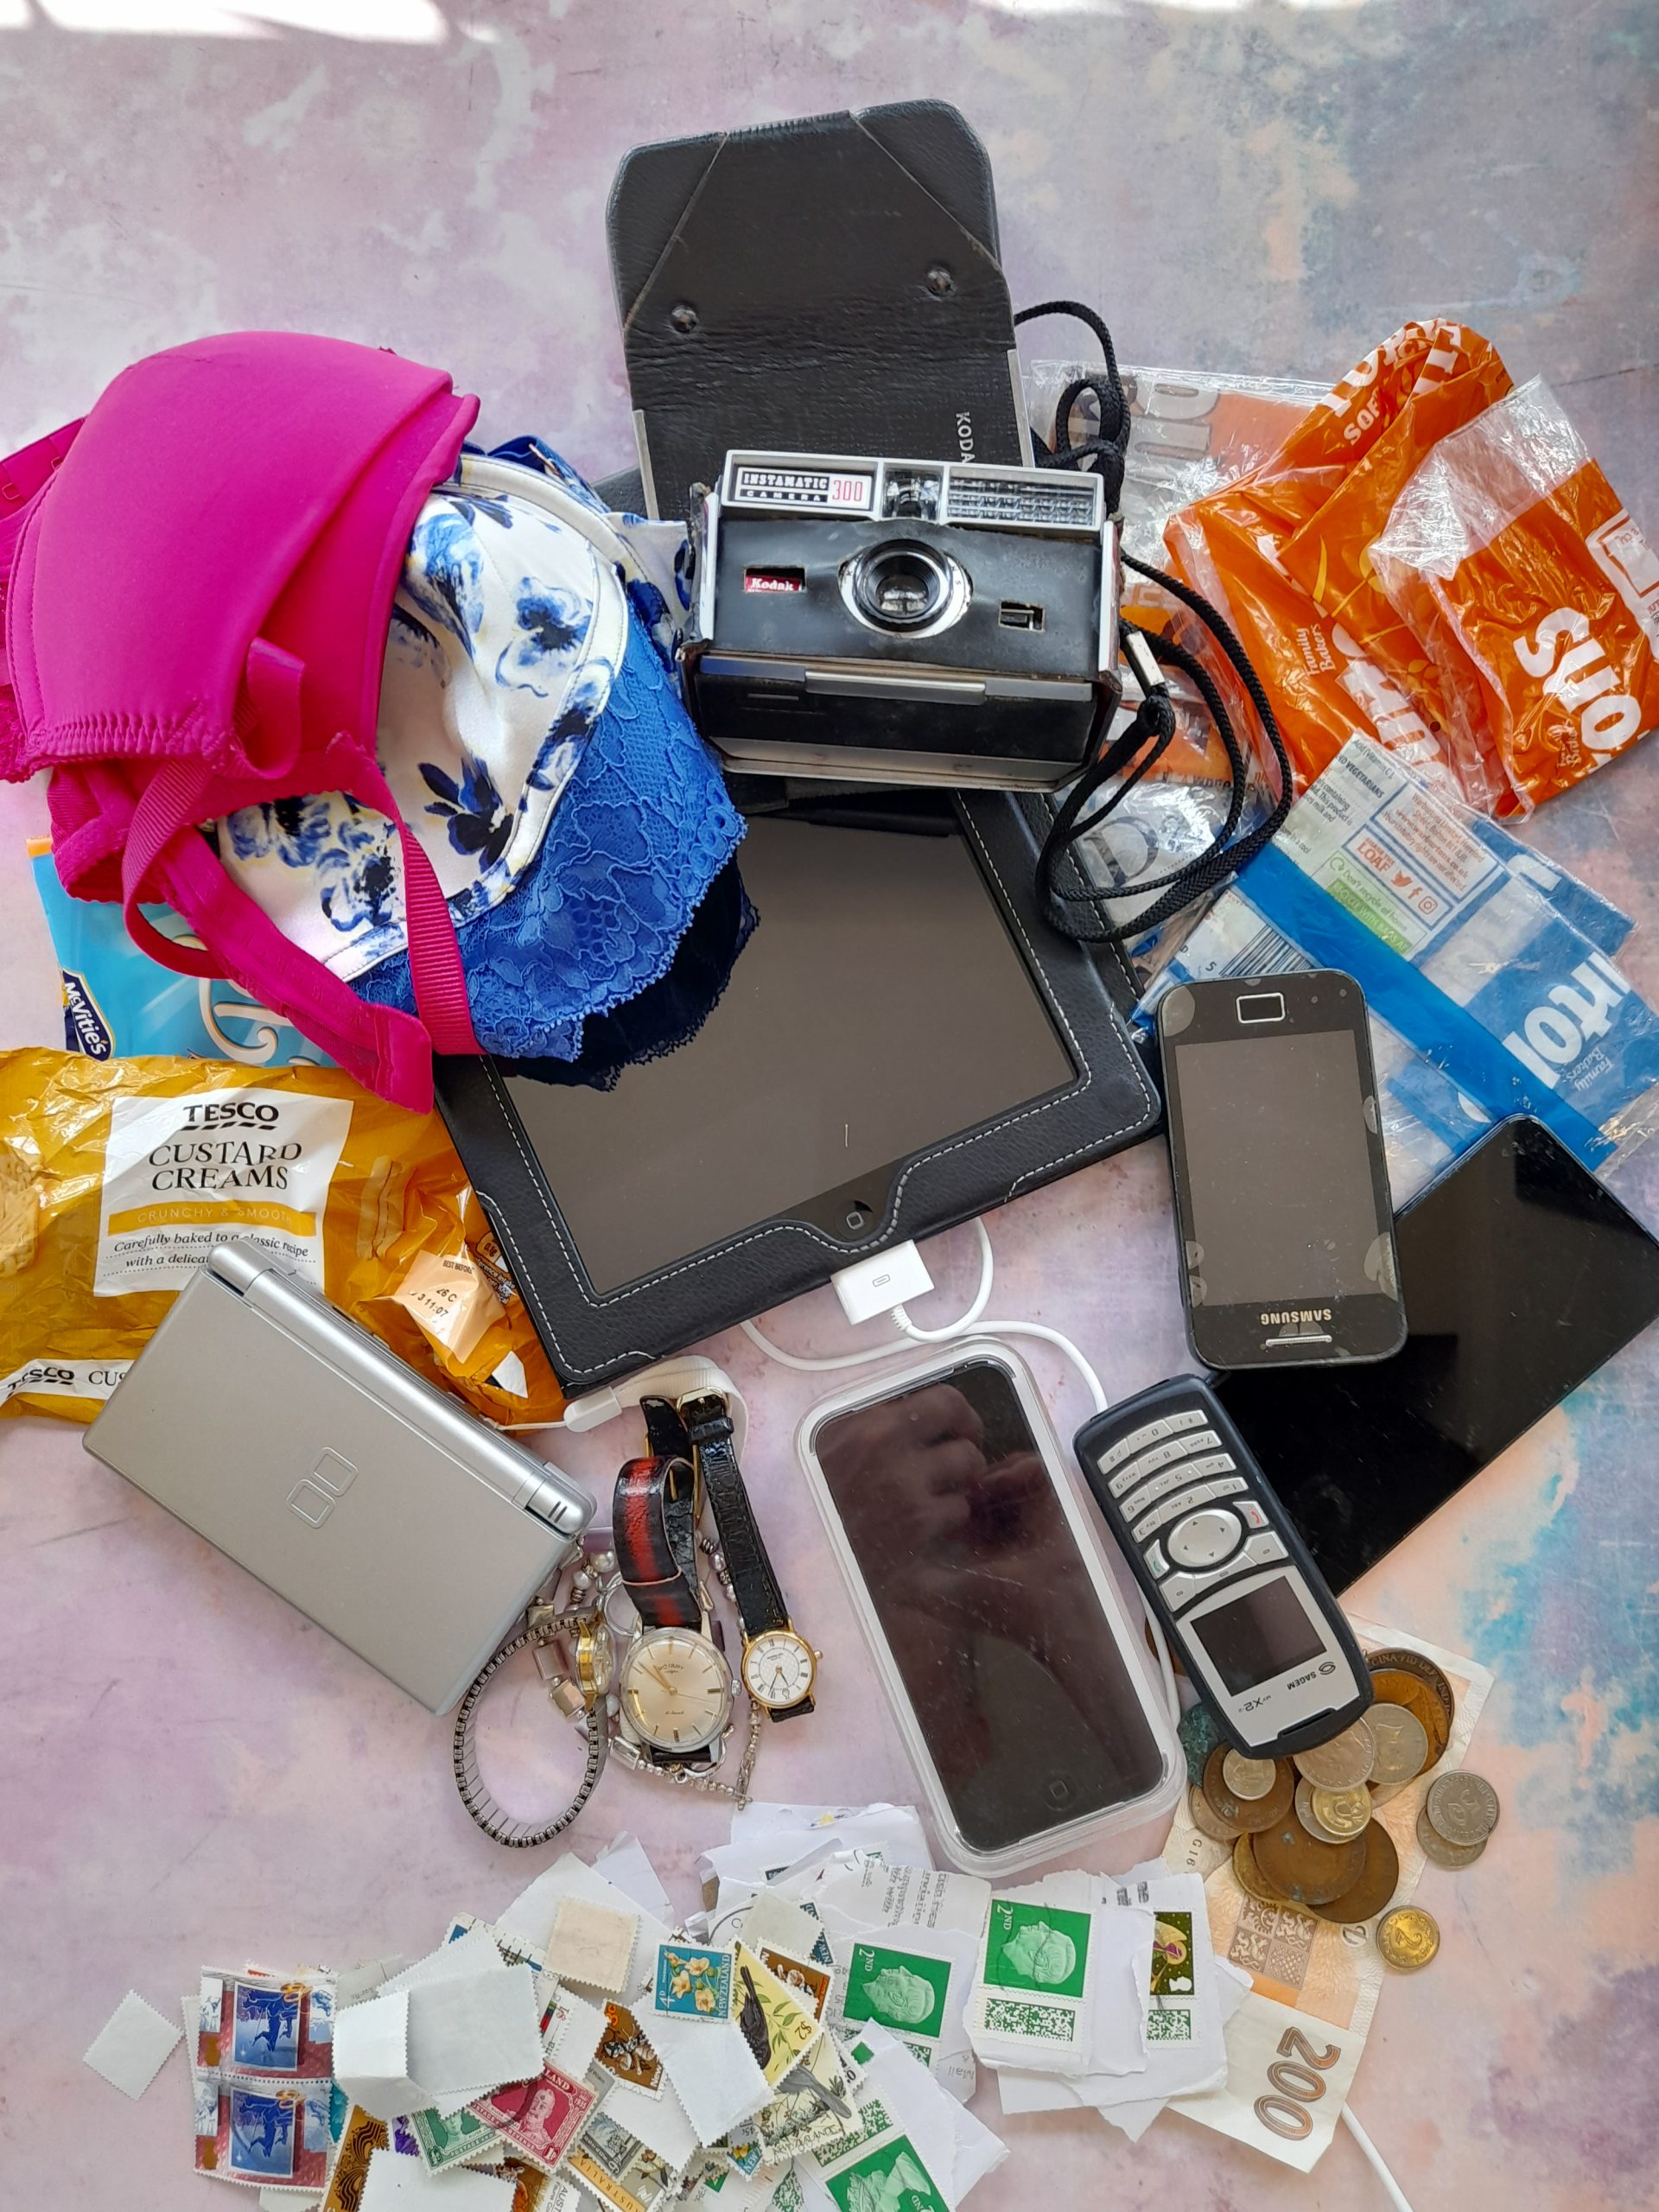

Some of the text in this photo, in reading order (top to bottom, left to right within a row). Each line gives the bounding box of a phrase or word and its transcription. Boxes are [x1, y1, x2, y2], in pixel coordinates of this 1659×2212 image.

[1344, 387, 1382, 446] SOF
[743, 473, 863, 502] INSTAMATIC 300
[747, 490, 821, 502] CAMERA
[751, 577, 794, 591] Kodak
[1296, 627, 1320, 676] Family
[1311, 624, 1336, 672] Bakers
[1343, 760, 1385, 799] VEGETARIANS
[1323, 810, 1336, 823] and
[1325, 801, 1349, 823] product
[1355, 840, 1392, 875] LOAF
[1341, 868, 1362, 889] Don't
[64, 981, 107, 1055] McVitie's
[1565, 1044, 1605, 1080] Bakers
[1574, 1057, 1615, 1092] Family
[183, 1102, 279, 1122] TESCO
[148, 1140, 302, 1166] CUSTARD
[152, 1164, 288, 1191] CREAMS
[137, 1207, 214, 1224] CRUNCHY
[237, 1206, 292, 1224] SMOOTH
[113, 1233, 171, 1253] Carefully
[174, 1231, 213, 1245] baked
[215, 1232, 229, 1243] to
[282, 1241, 309, 1257] recipe
[125, 1255, 154, 1268] with
[156, 1256, 165, 1265] a
[442, 1260, 454, 1270] BEST
[424, 1299, 449, 1318] 11:07
[1260, 1308, 1332, 1325] SAMSUNG
[1287, 1670, 1317, 1690] SAGEM
[996, 1904, 1014, 1931] 2ND
[859, 1947, 875, 1973] 2ND
[556, 2005, 570, 2021] $1
[794, 2020, 812, 2040] $2
[649, 2064, 664, 2088] New
[1254, 2026, 1341, 2141] 200
[574, 2096, 588, 2110] 1935
[506, 2127, 536, 2152] REVENUE
